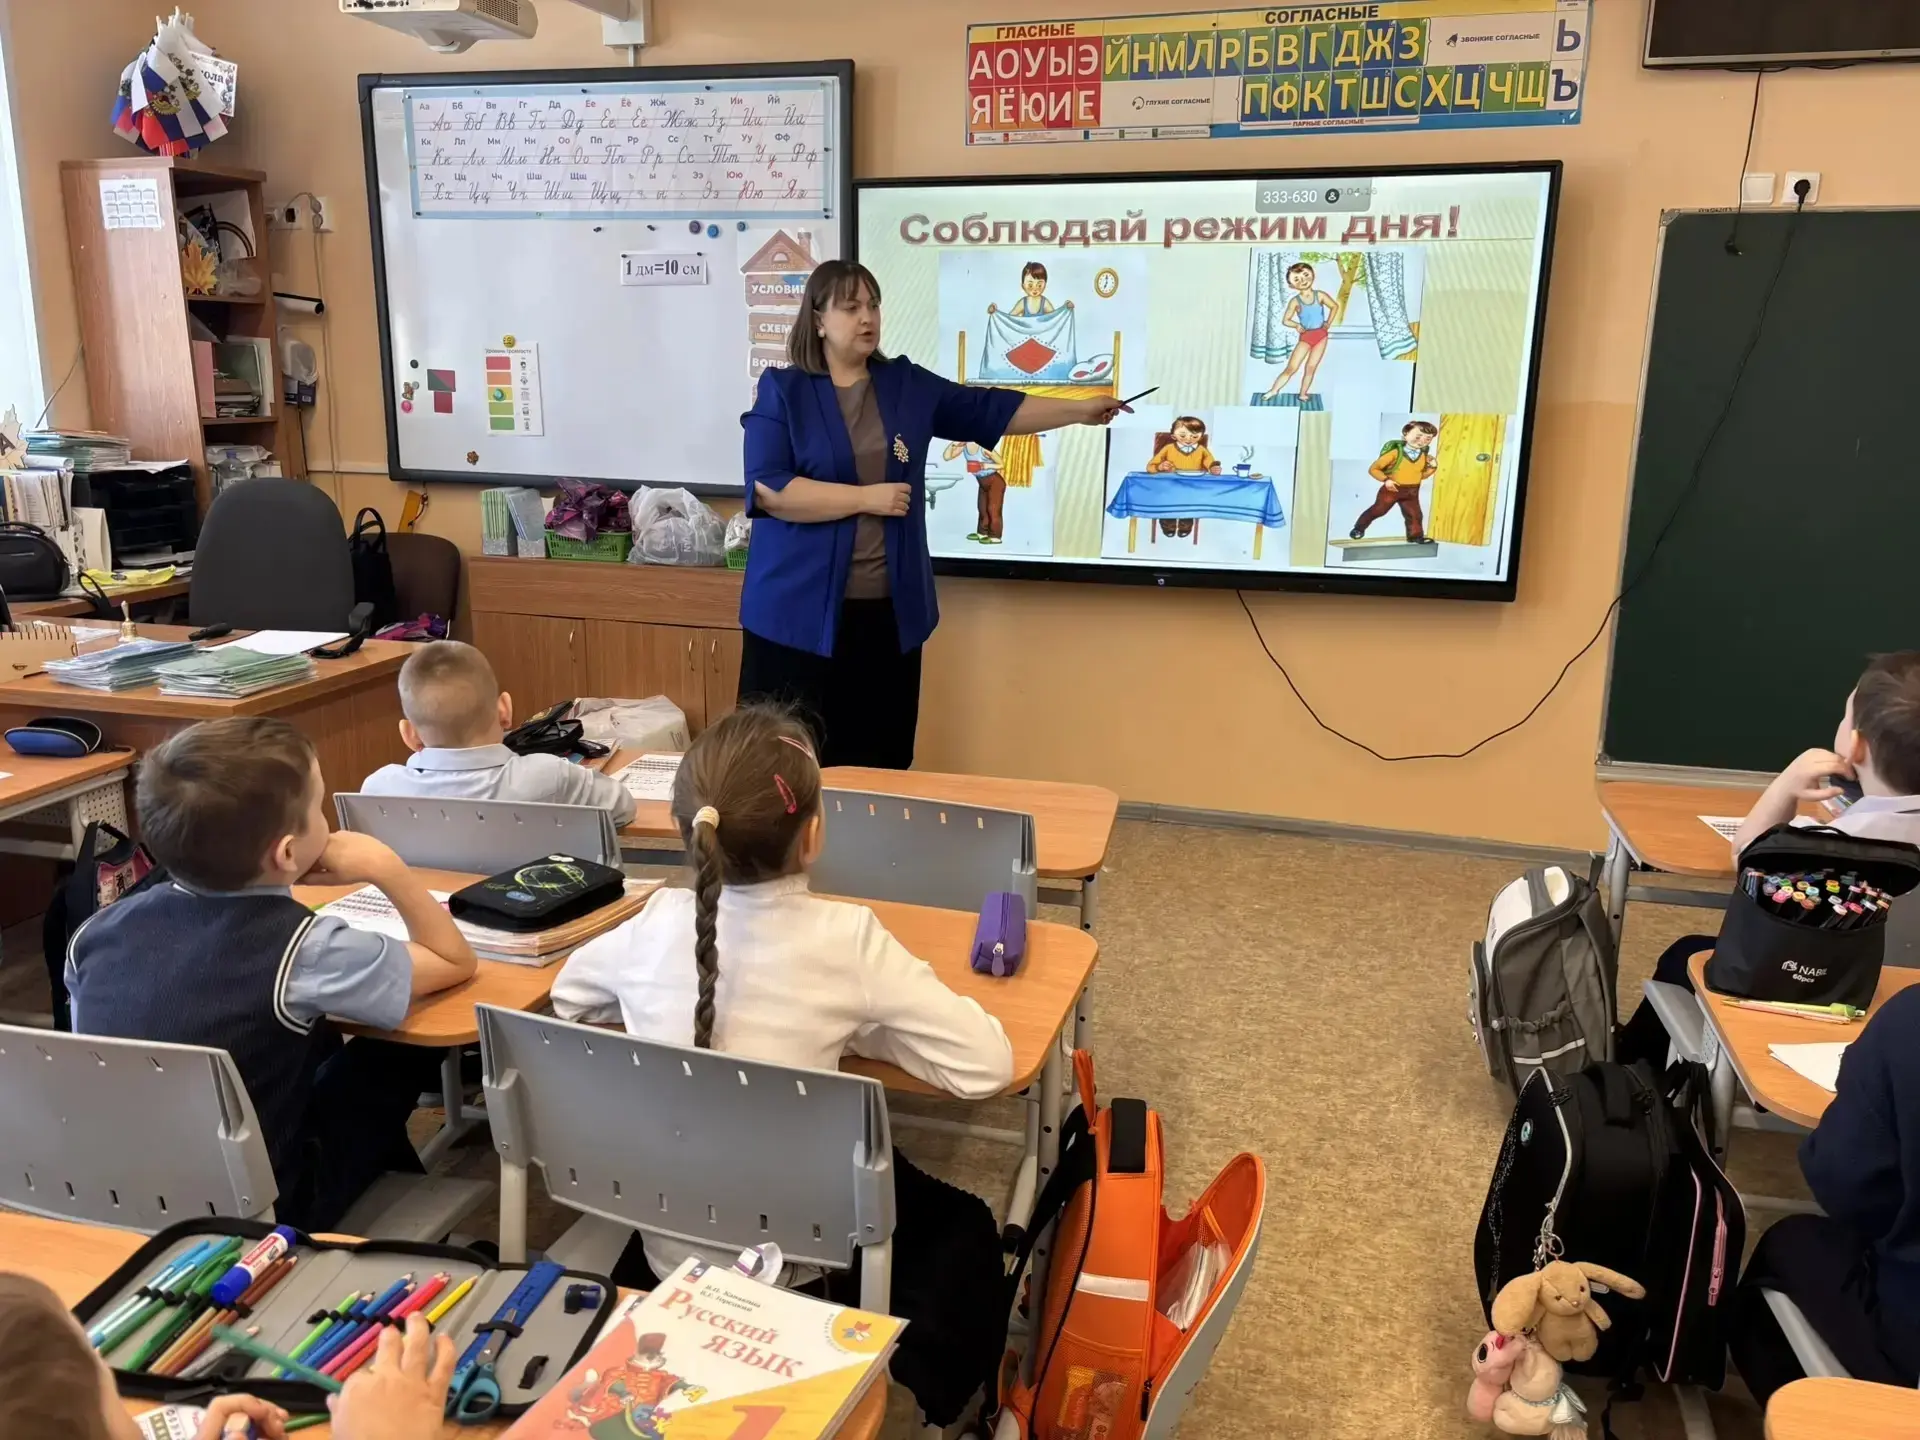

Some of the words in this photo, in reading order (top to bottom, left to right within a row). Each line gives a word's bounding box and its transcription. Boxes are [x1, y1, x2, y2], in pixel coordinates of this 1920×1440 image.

[1264, 5, 1380, 25] СОГЛАСНЫЕ
[996, 23, 1076, 41] ГЛАСНЫЕ
[1495, 33, 1541, 41] СОГЛАСНЫЕ
[1171, 97, 1211, 105] СОГЛАСНЫЕ
[1322, 118, 1365, 126] СОГЛАСНЫЕ
[1262, 190, 1318, 204] 333-630
[899, 208, 1148, 248] Соблюдай
[1163, 213, 1329, 248] режим
[1340, 205, 1461, 245] дня!
[626, 260, 632, 275] 1
[683, 264, 700, 275] см
[759, 323, 793, 334] СХЕМ
[658, 1287, 780, 1345] Русский
[701, 1334, 804, 1379] ЯЗЫК
